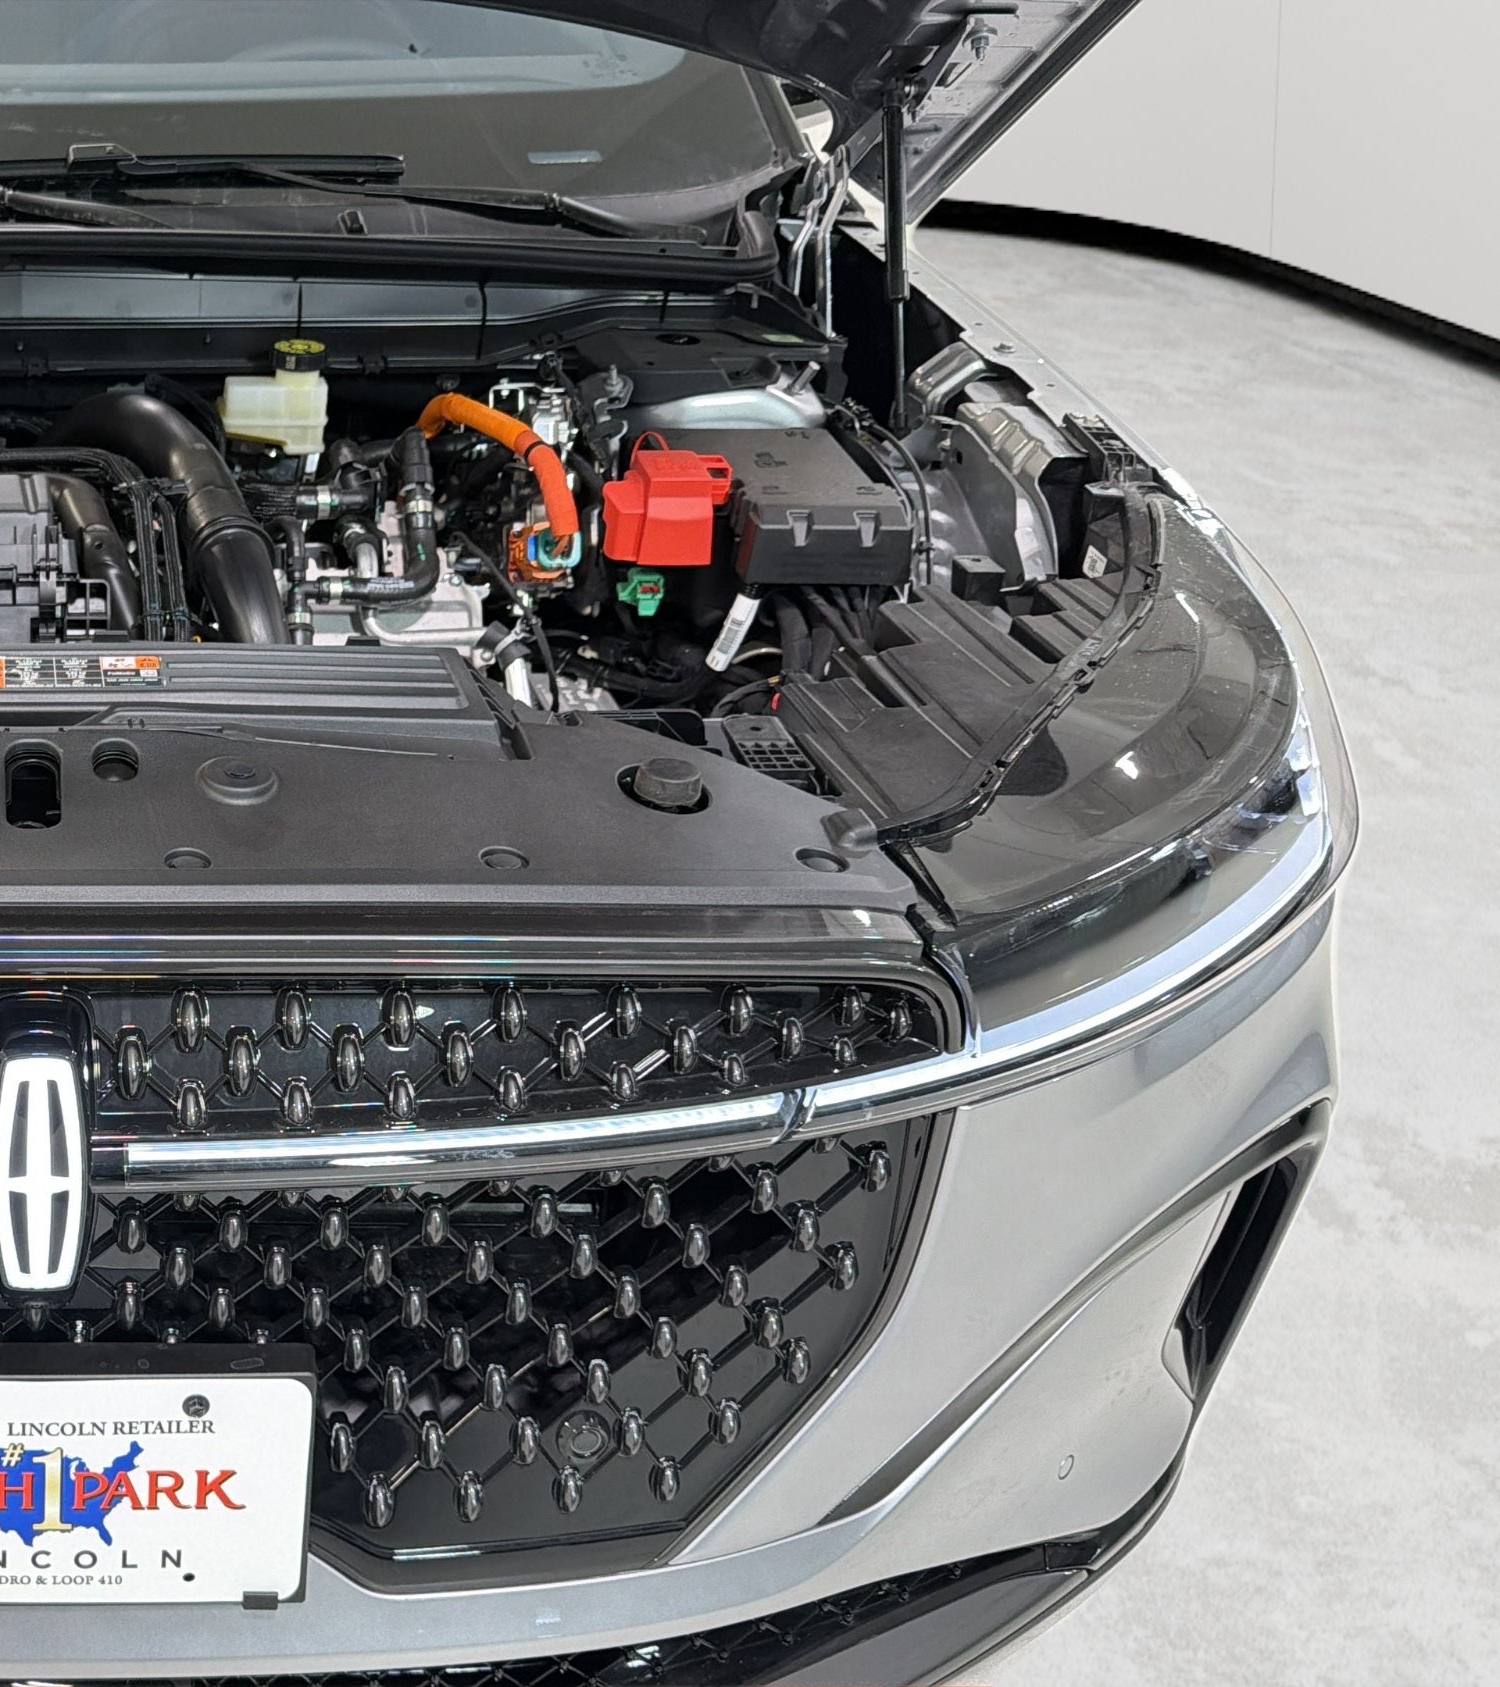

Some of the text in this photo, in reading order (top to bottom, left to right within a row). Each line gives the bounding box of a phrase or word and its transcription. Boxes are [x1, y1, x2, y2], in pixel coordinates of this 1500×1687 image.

[7, 1421, 107, 1437] LINCOLN
[112, 1420, 215, 1435] RETAILER
[72, 1469, 246, 1510] PARK
[36, 1575, 48, 1585] &
[52, 1575, 94, 1585] LOOP
[98, 1575, 123, 1585] 410
